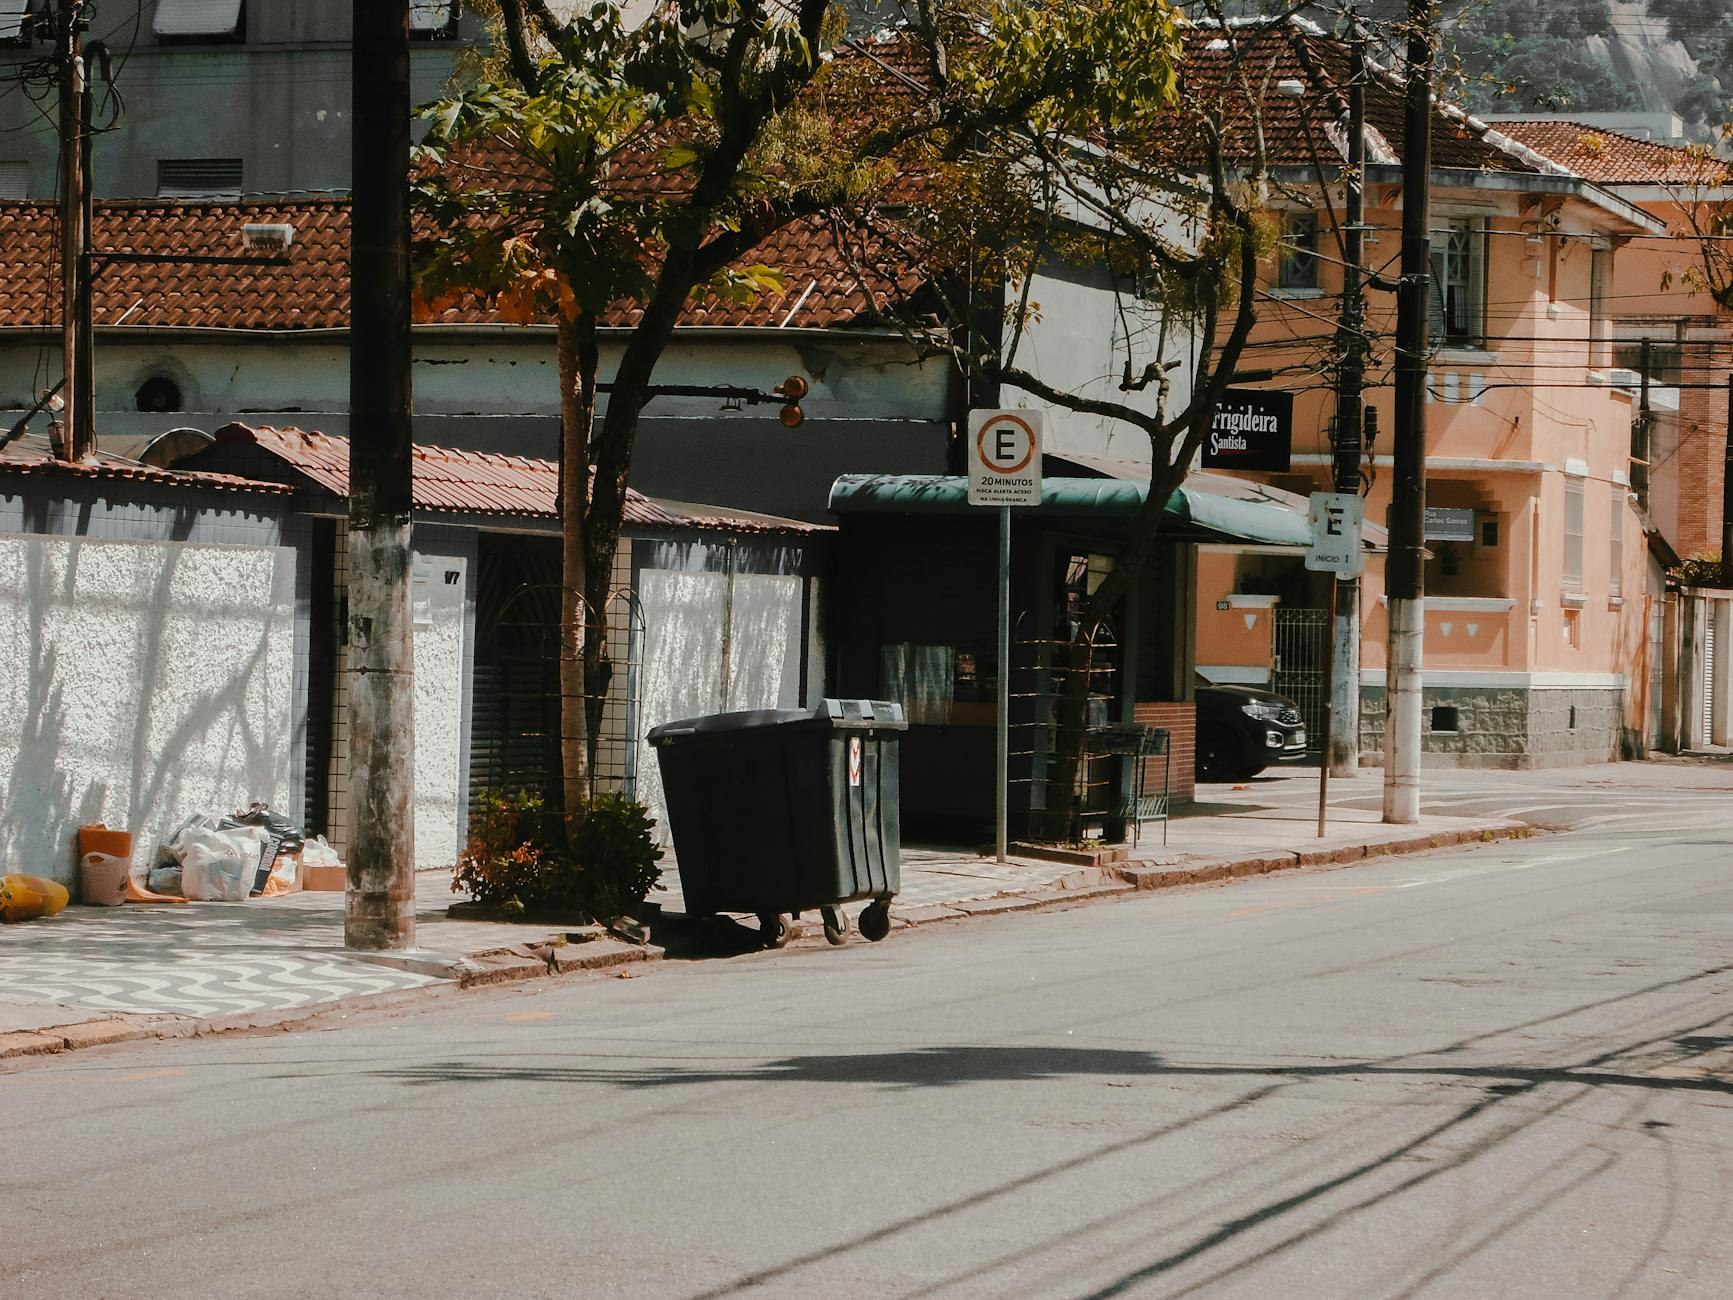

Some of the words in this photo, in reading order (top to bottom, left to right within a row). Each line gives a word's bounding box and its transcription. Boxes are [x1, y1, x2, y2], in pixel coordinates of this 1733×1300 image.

[995, 429, 1015, 460] E
[1210, 432, 1247, 456] Santista
[981, 476, 994, 486] 20
[994, 478, 1033, 487] MINUTOS
[1327, 508, 1344, 536] E
